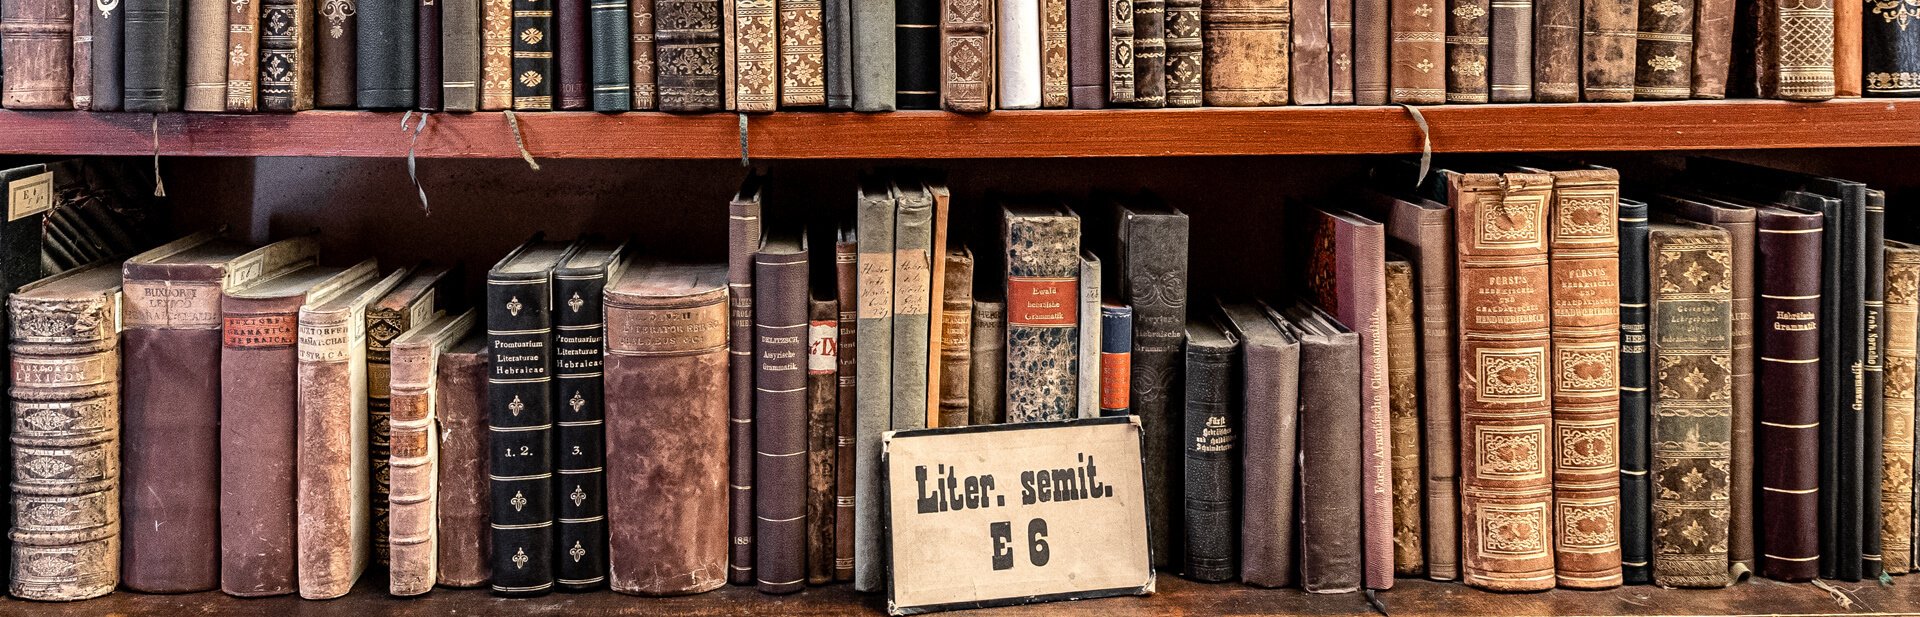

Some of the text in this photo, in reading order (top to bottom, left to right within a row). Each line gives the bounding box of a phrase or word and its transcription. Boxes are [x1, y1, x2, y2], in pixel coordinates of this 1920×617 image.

[494, 340, 543, 349] Promtuarium
[557, 347, 598, 356] Literaturae
[497, 354, 539, 363] Literaturae
[496, 366, 544, 375] Hebraicae
[16, 372, 85, 382] LEXICON
[520, 446, 534, 456] 2.
[572, 445, 583, 456] 3.
[915, 452, 1113, 513] Liter. semit.
[990, 517, 1050, 571] E 6
